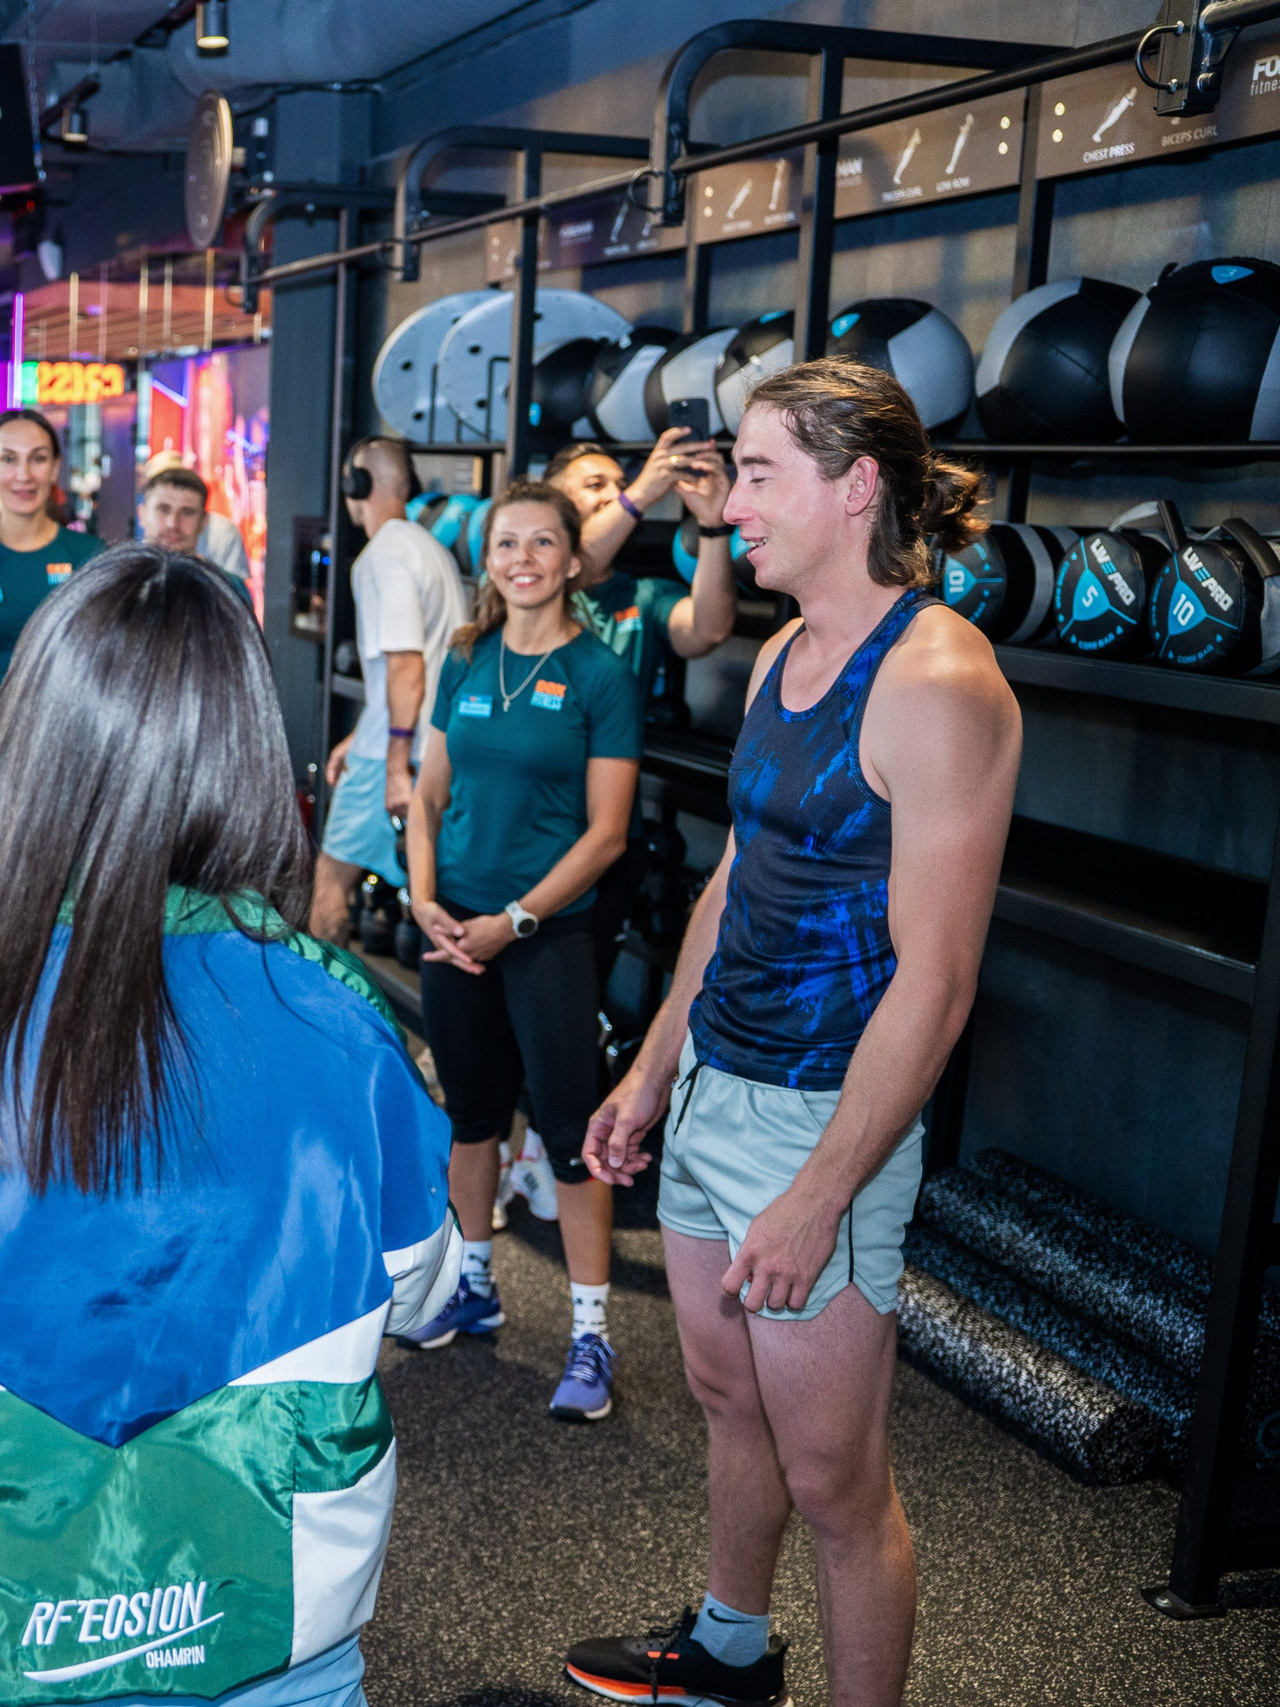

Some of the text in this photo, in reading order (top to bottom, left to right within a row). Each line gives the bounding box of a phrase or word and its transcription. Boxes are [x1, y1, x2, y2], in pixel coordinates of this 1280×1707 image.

[1253, 55, 1280, 80] FO
[1161, 125, 1218, 147] BICEPS CURL
[1083, 142, 1135, 163] CHEST PRESS
[949, 570, 965, 593] 10
[1082, 585, 1098, 607] 5
[1173, 593, 1195, 626] 10
